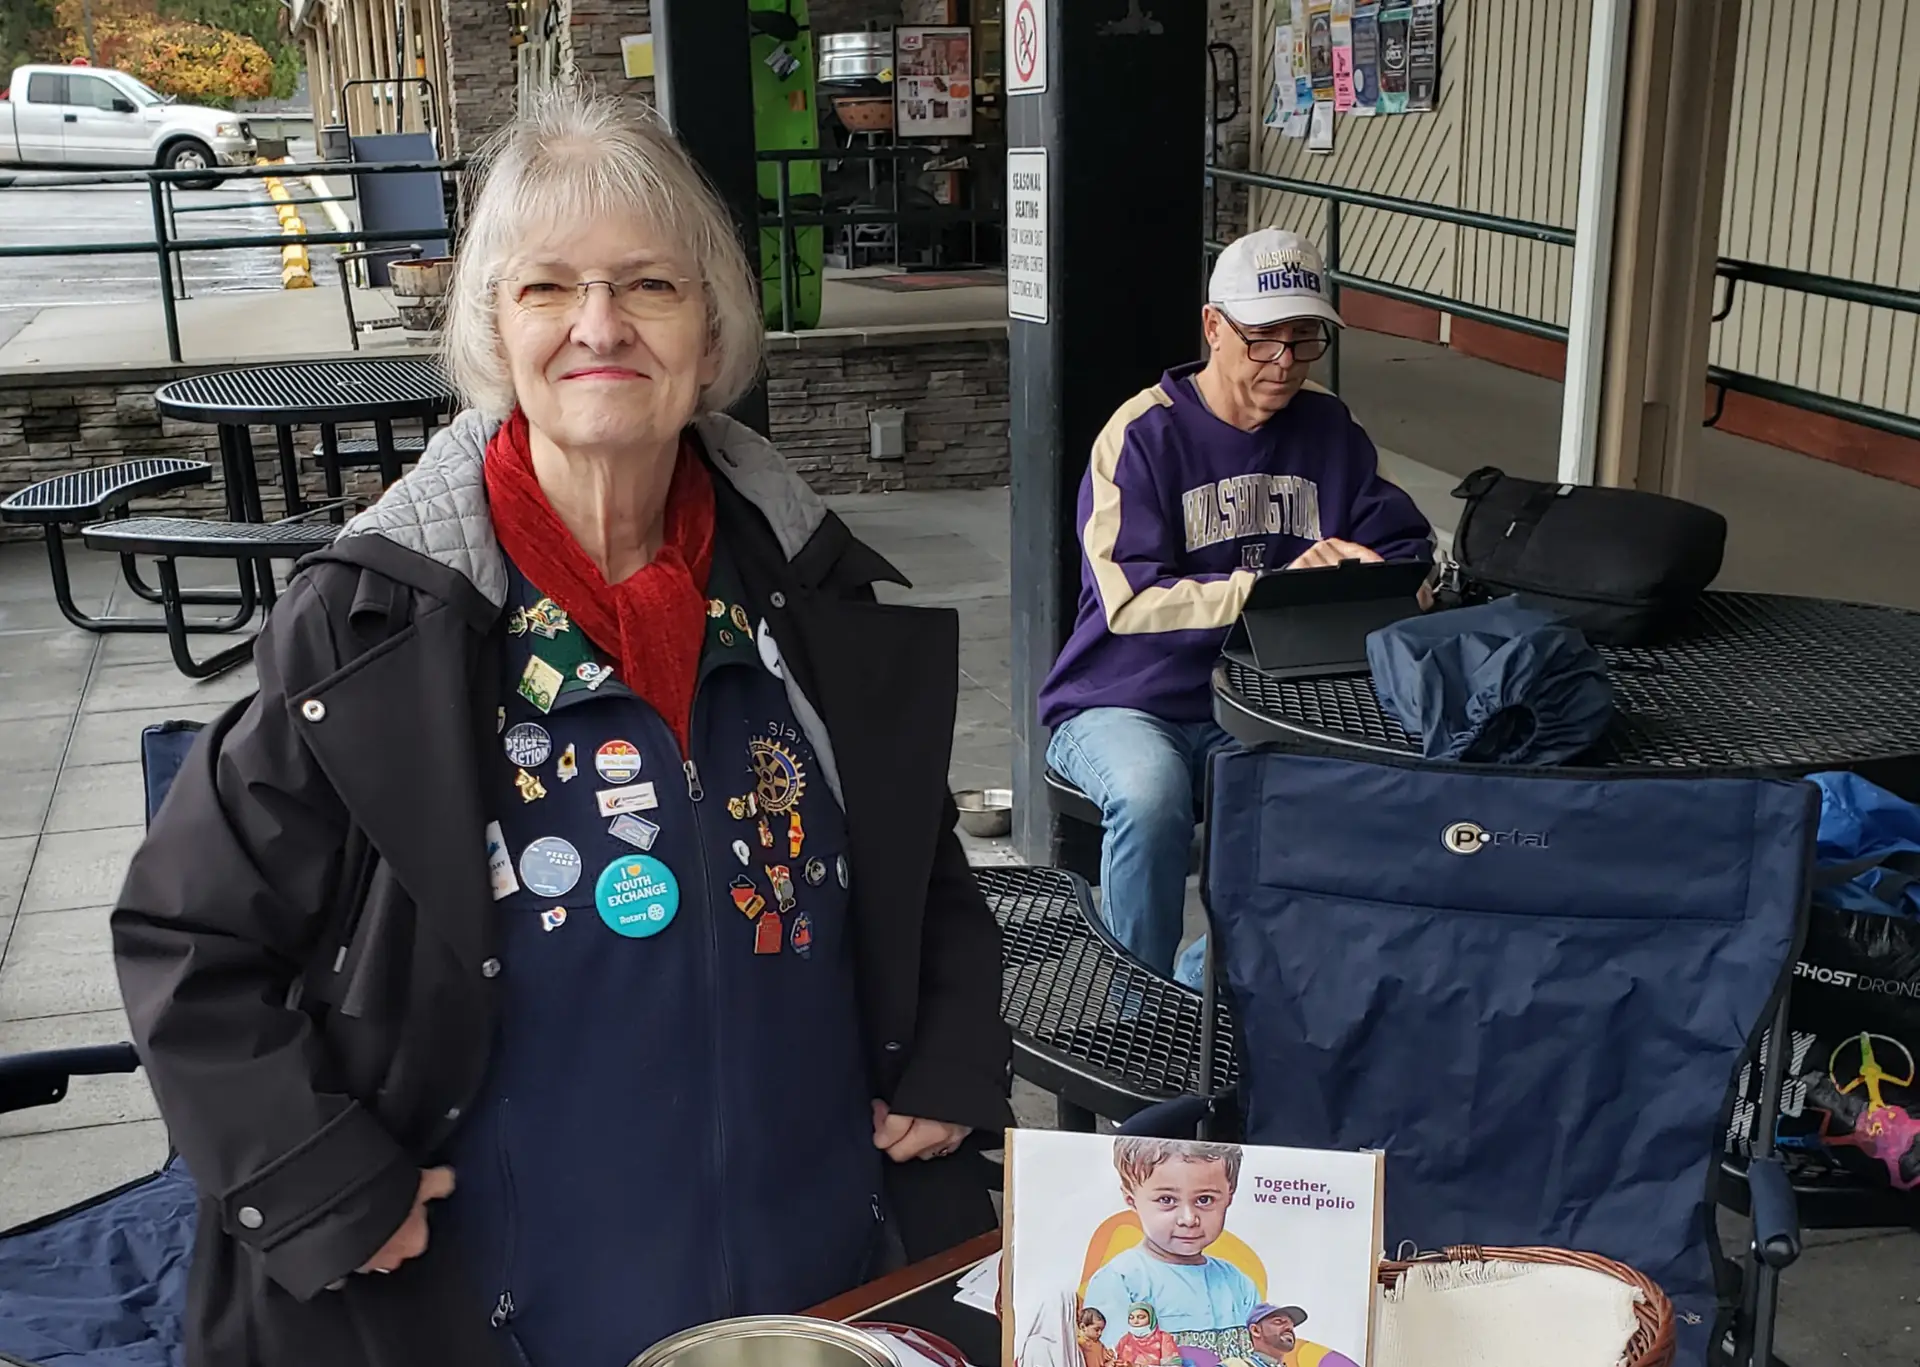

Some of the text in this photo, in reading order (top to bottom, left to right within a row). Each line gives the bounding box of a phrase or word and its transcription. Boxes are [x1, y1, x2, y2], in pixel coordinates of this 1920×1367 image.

[1013, 172, 1041, 191] SEASONAL
[1015, 200, 1039, 218] SEATING
[1282, 261, 1301, 274] W
[1182, 473, 1322, 553] WASHINGTON
[505, 738, 538, 752] PEACE
[510, 747, 548, 765] ACTION
[546, 850, 575, 861] PEACE
[549, 858, 574, 867] PARK
[621, 867, 627, 880] I
[613, 875, 652, 893] YOUTH
[607, 882, 668, 907] EXCHANGE
[619, 912, 647, 925] Rotary
[1254, 1176, 1331, 1195] Together,
[1254, 1193, 1355, 1210] we end polio
